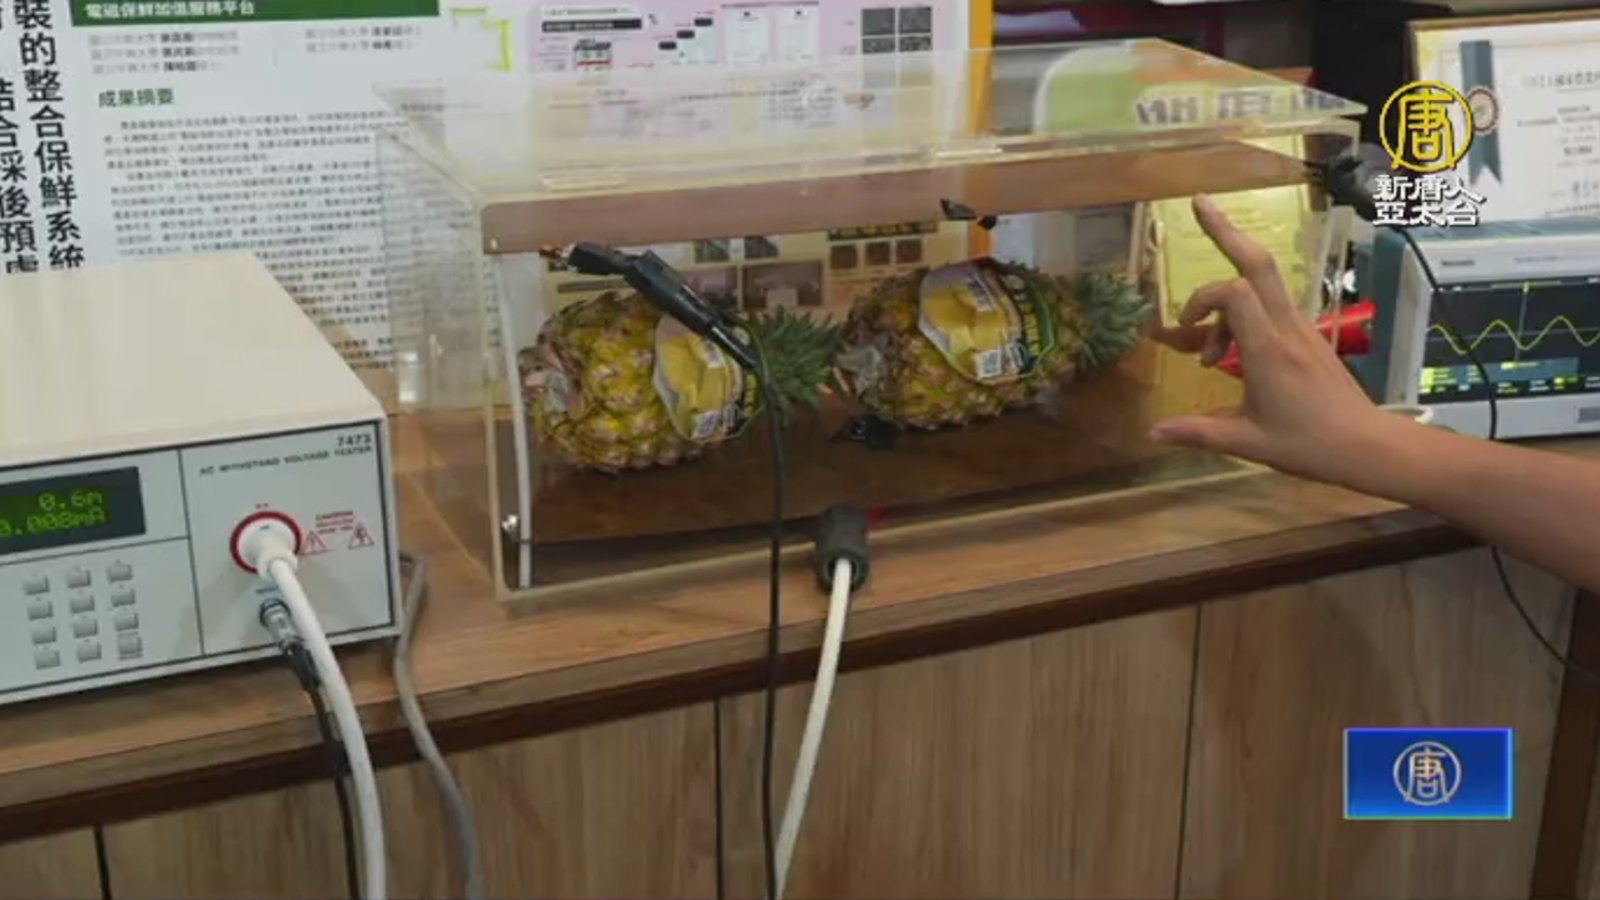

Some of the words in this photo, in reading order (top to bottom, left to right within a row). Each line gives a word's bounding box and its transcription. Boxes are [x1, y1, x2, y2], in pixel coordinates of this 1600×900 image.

[99, 88, 174, 108] 成果摘要
[284, 450, 330, 464] VOLTAGE
[334, 445, 372, 457] TESTER
